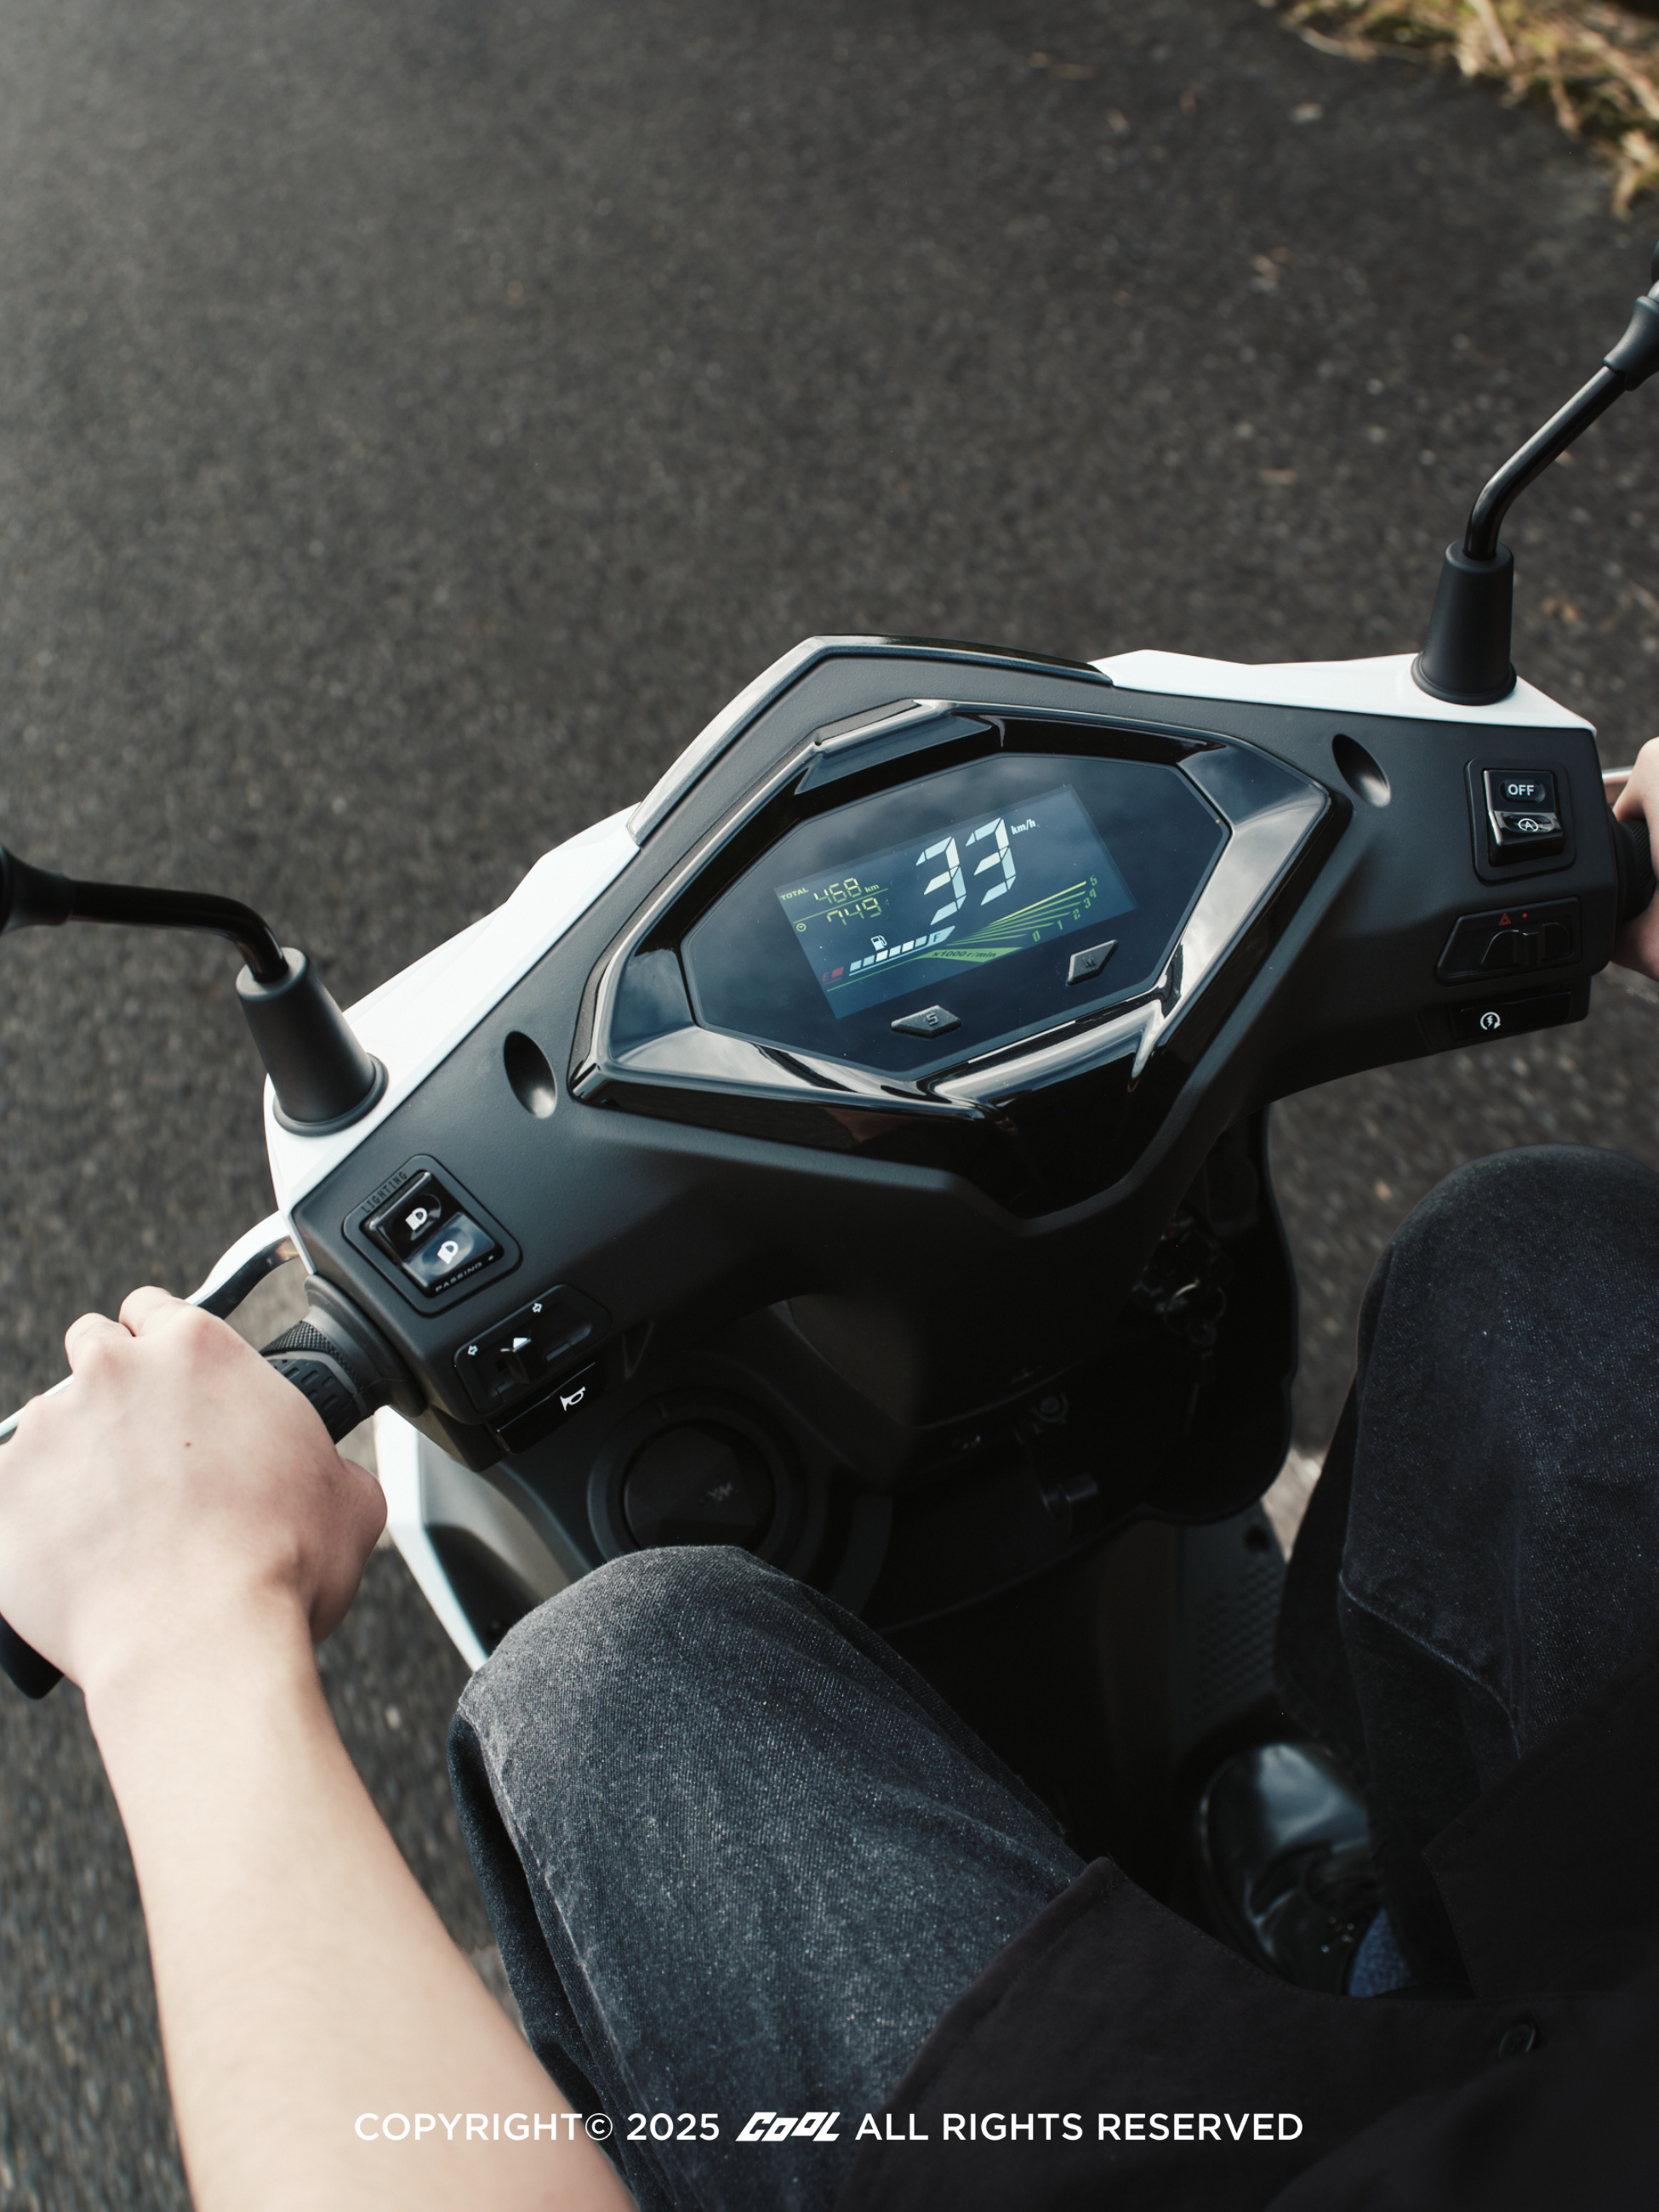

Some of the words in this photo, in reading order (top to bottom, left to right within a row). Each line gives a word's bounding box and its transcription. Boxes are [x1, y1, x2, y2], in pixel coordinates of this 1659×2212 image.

[1508, 784, 1535, 796] OFF
[915, 818, 1017, 926] 33
[1011, 818, 1036, 835] km/h
[1089, 875, 1097, 887] 5
[780, 887, 809, 901] TOTAL
[813, 877, 863, 904] 468
[864, 884, 880, 893] km
[1089, 888, 1097, 898] 4
[1083, 897, 1092, 909] 3
[826, 897, 882, 926] 749
[1072, 909, 1080, 921] 2
[1057, 920, 1064, 931] 1
[932, 932, 941, 943] F
[1032, 930, 1041, 942] 0
[1081, 955, 1097, 969] M
[822, 972, 830, 982] E
[926, 1012, 939, 1025] S
[361, 1172, 408, 1214] LIGHTING
